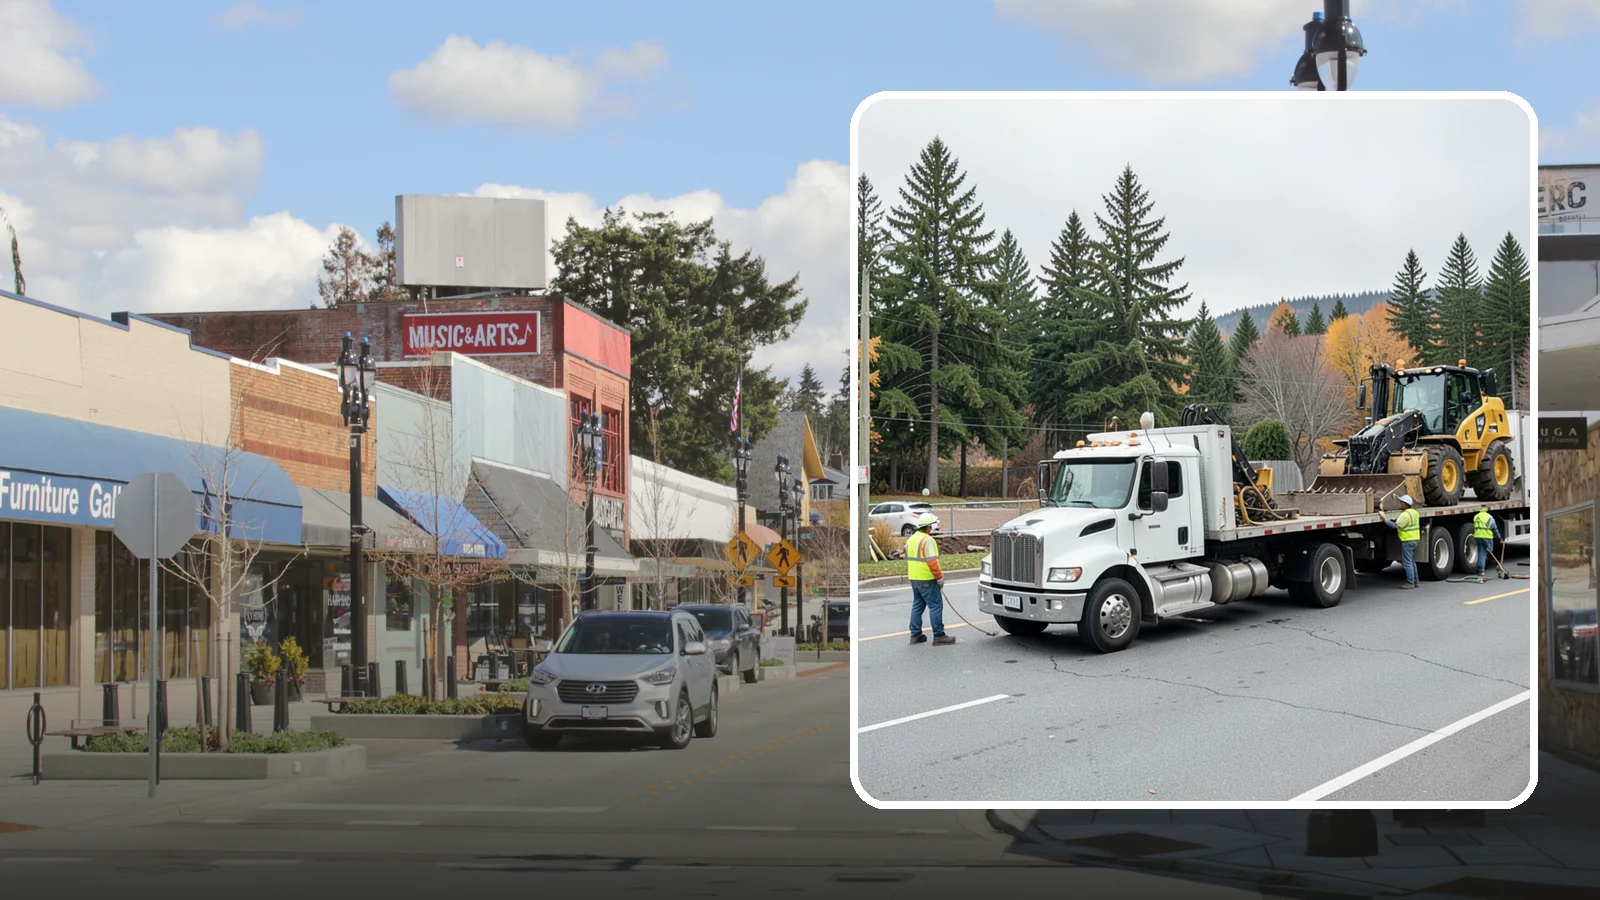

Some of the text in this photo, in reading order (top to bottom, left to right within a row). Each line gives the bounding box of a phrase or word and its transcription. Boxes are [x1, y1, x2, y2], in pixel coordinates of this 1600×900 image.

[408, 322, 520, 349] MUSIC&ARTS
[0, 471, 121, 519] Furniture Gal
[453, 563, 479, 574] SUSHI
